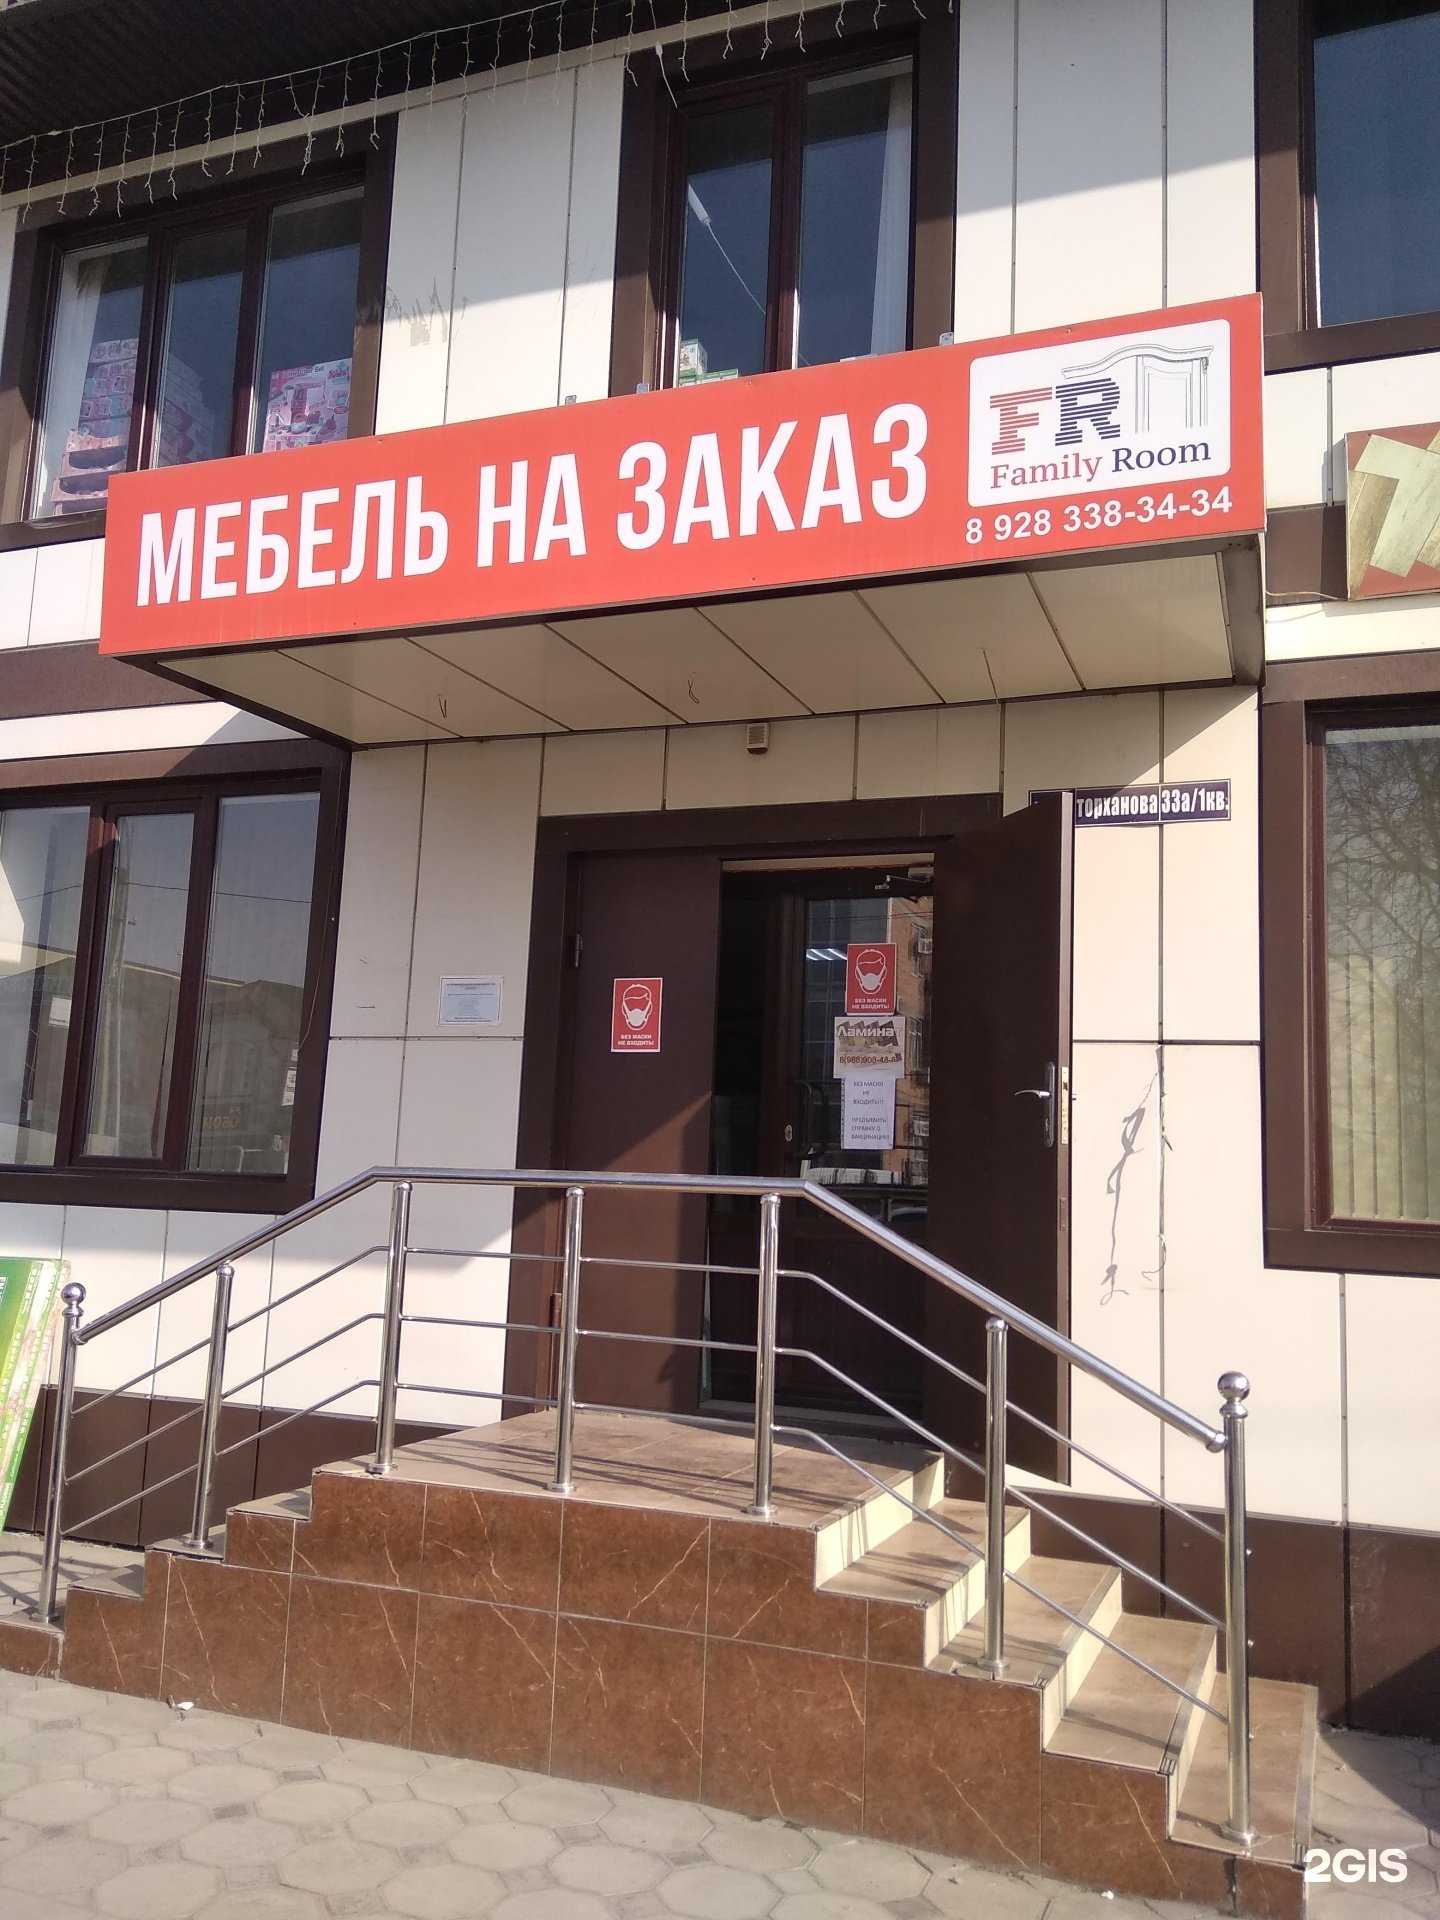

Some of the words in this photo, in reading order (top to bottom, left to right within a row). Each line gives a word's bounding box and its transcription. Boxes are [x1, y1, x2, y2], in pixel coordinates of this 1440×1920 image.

[990, 377, 1121, 455] FR
[990, 453, 1102, 489] Family
[1112, 440, 1211, 473] Room
[136, 475, 449, 607] МЕБЕЛЬ
[476, 452, 587, 568] НА
[616, 403, 928, 551] ЗАКАЗ
[965, 518, 983, 544] 8
[994, 509, 1051, 541] 928
[1063, 486, 1232, 532] 338-34-34
